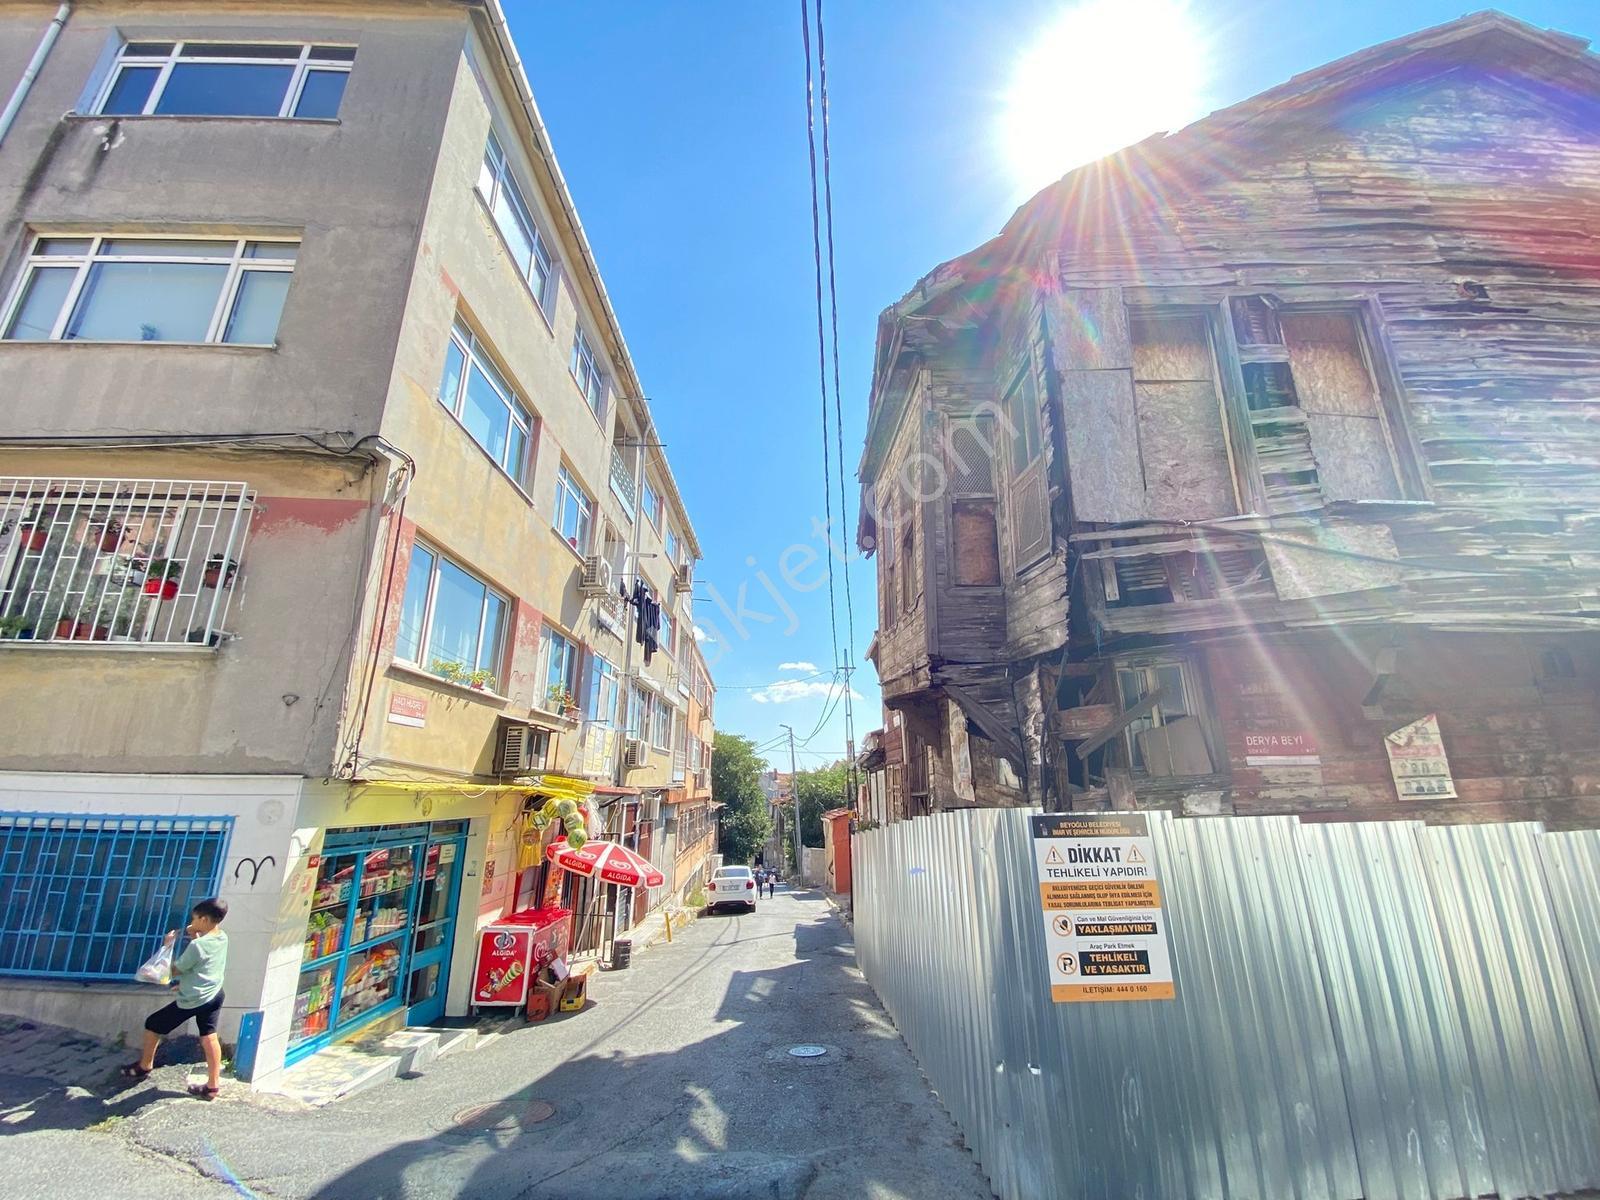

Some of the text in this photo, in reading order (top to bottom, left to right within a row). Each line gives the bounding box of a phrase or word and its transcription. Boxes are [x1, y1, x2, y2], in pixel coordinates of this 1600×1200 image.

[1246, 735, 1278, 746] DERYA
[1067, 843, 1121, 864] DİKKAT
[564, 857, 586, 870] ALGIDA
[607, 871, 632, 882] ALGIDA
[1046, 865, 1148, 878] TEHLİKELİ YAPIDIR!
[1096, 914, 1107, 922] Mal
[1078, 923, 1153, 935] YAKLAŞMAYINIZ
[1089, 943, 1103, 951] Araç
[1089, 951, 1138, 963] TEHLİKELİ
[1084, 964, 1146, 974] VE YASAKTIR
[1082, 985, 1115, 995] İLETİŞİM:
[1129, 985, 1134, 993] 0
